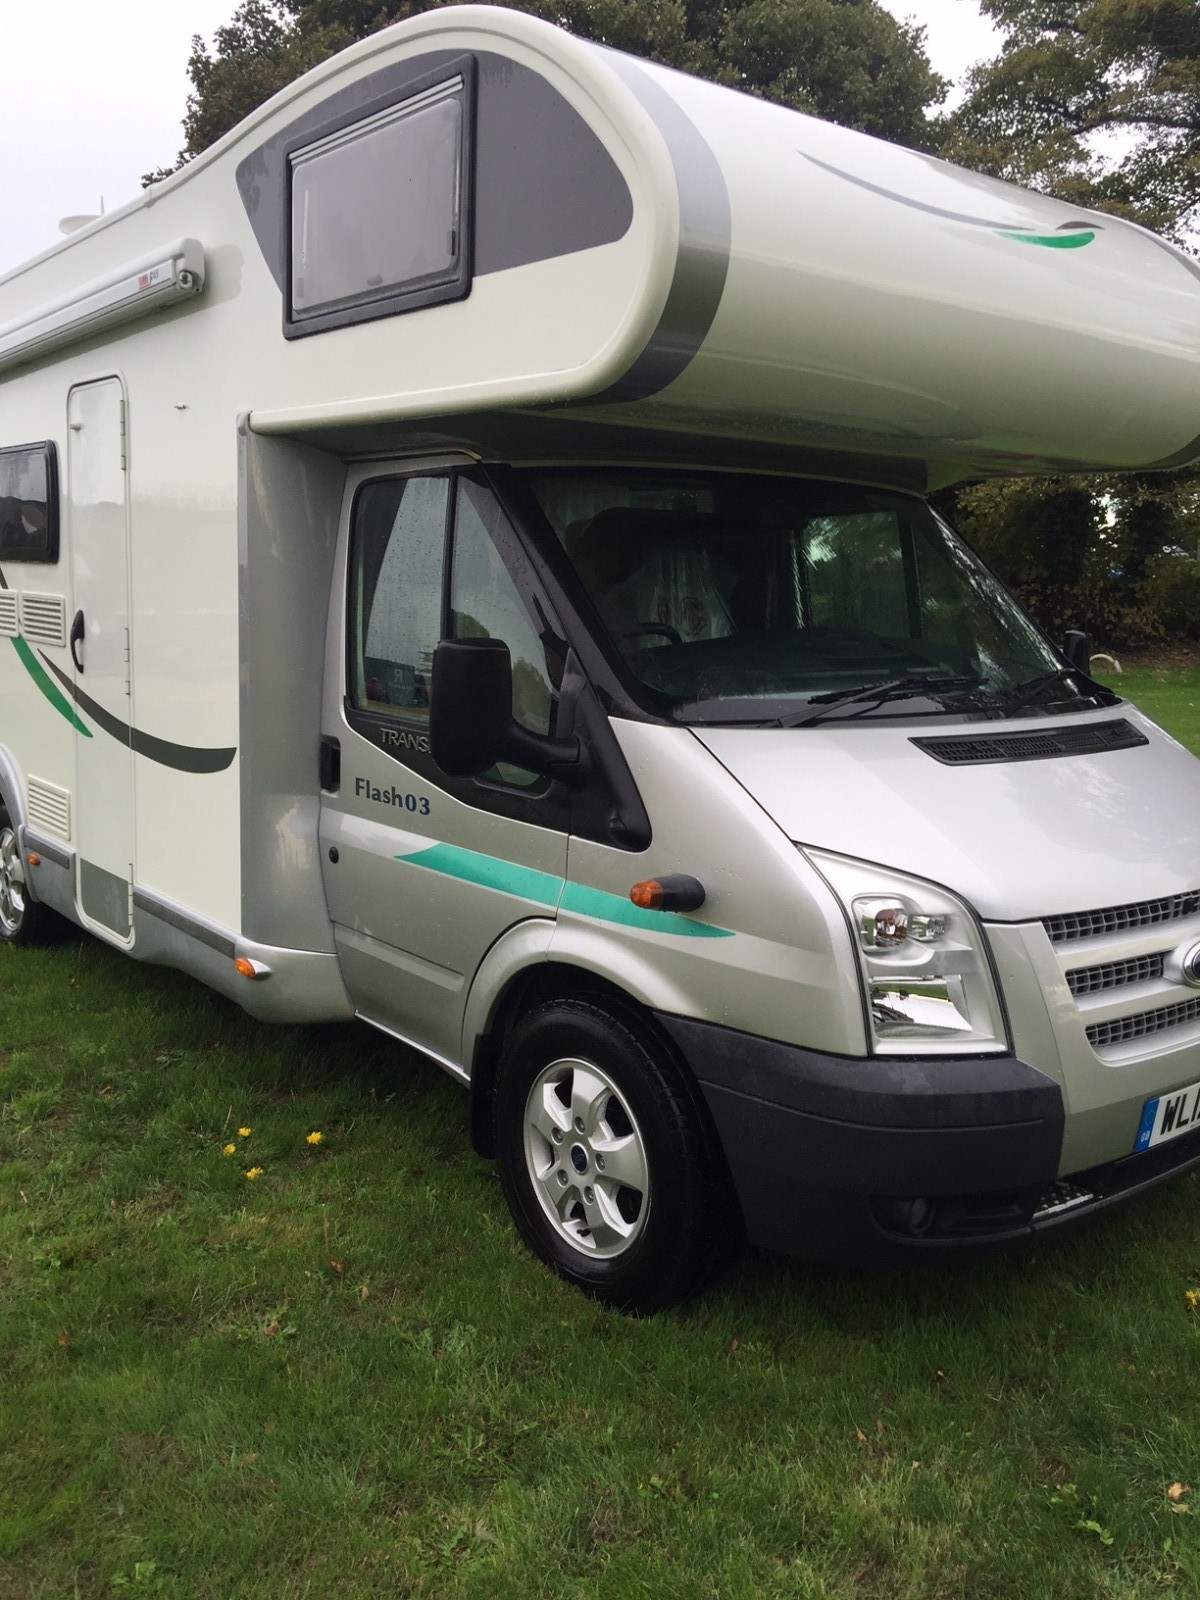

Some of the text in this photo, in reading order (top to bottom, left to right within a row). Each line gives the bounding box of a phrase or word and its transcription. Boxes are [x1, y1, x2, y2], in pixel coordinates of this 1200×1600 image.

[380, 727, 431, 754] TRANS
[355, 777, 431, 816] Flash03
[1140, 1130, 1151, 1142] GB
